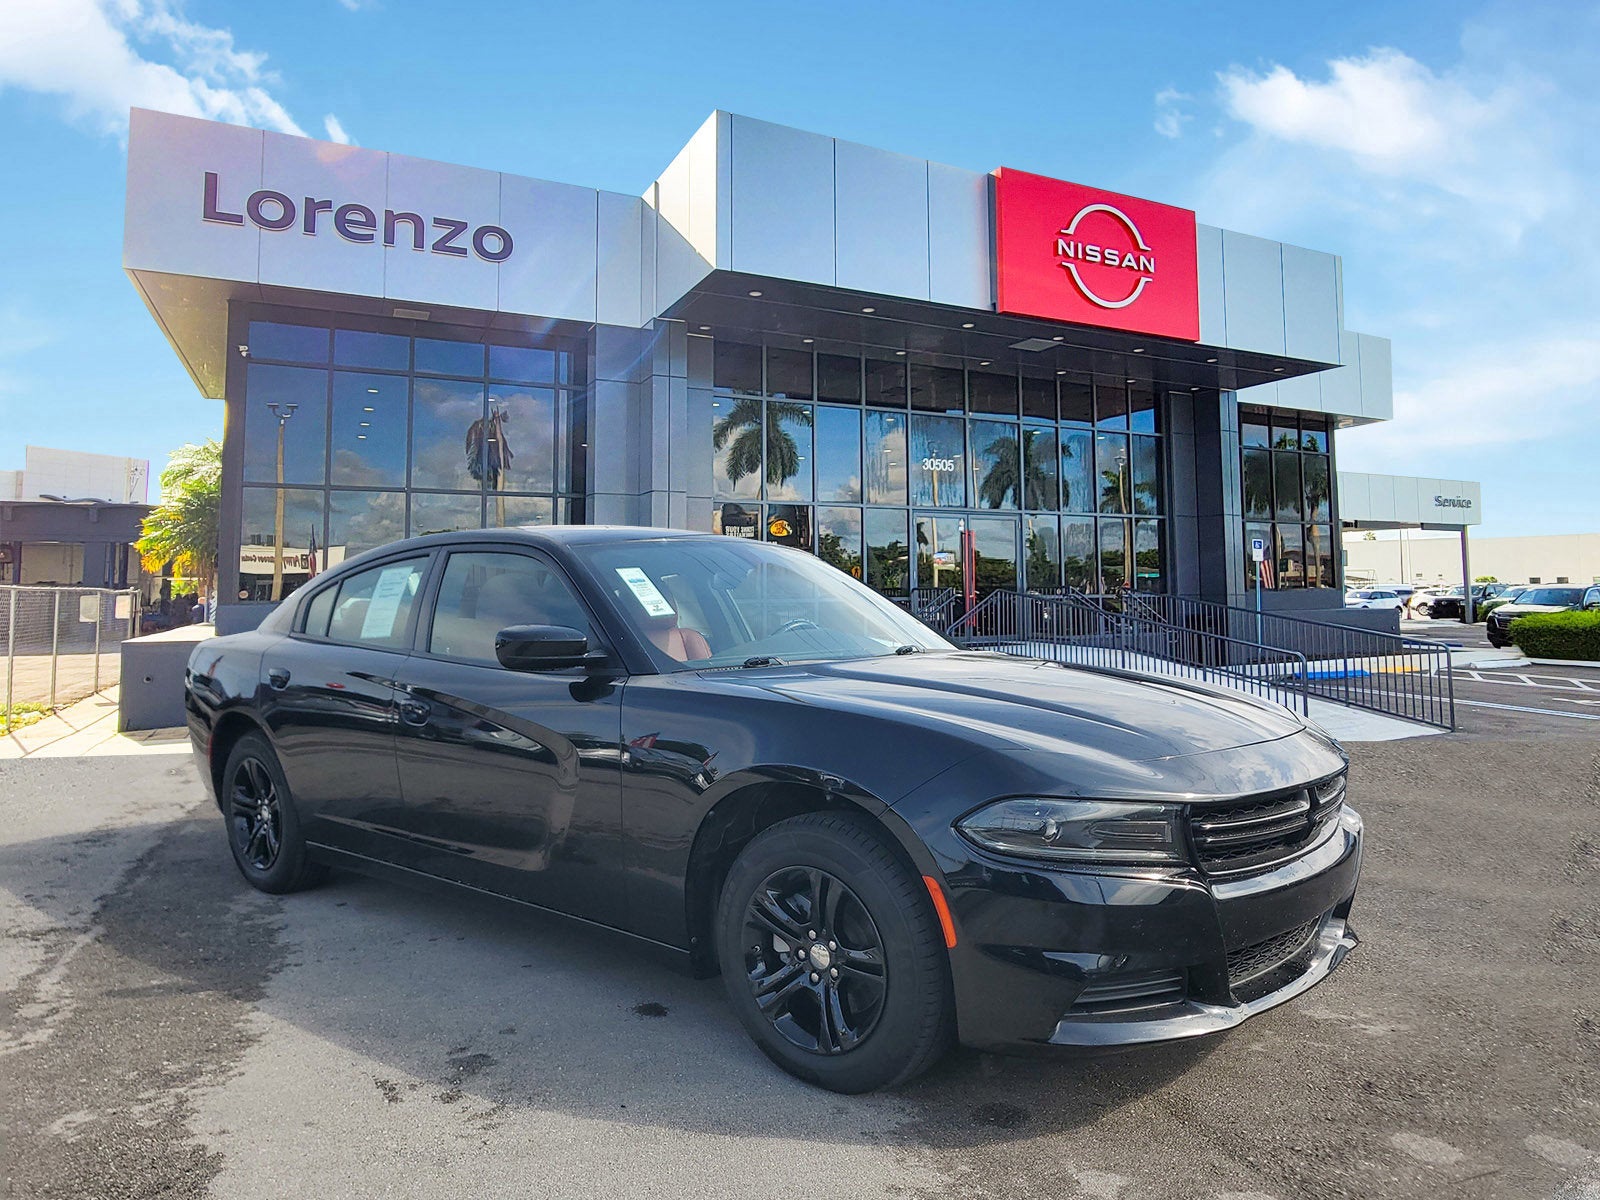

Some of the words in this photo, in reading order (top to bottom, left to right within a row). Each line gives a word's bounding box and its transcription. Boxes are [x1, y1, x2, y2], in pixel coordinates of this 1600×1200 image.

[202, 171, 514, 262] Lorenzo
[1057, 238, 1155, 273] NISSAN
[922, 458, 955, 471] 30505
[1434, 495, 1472, 508] Service
